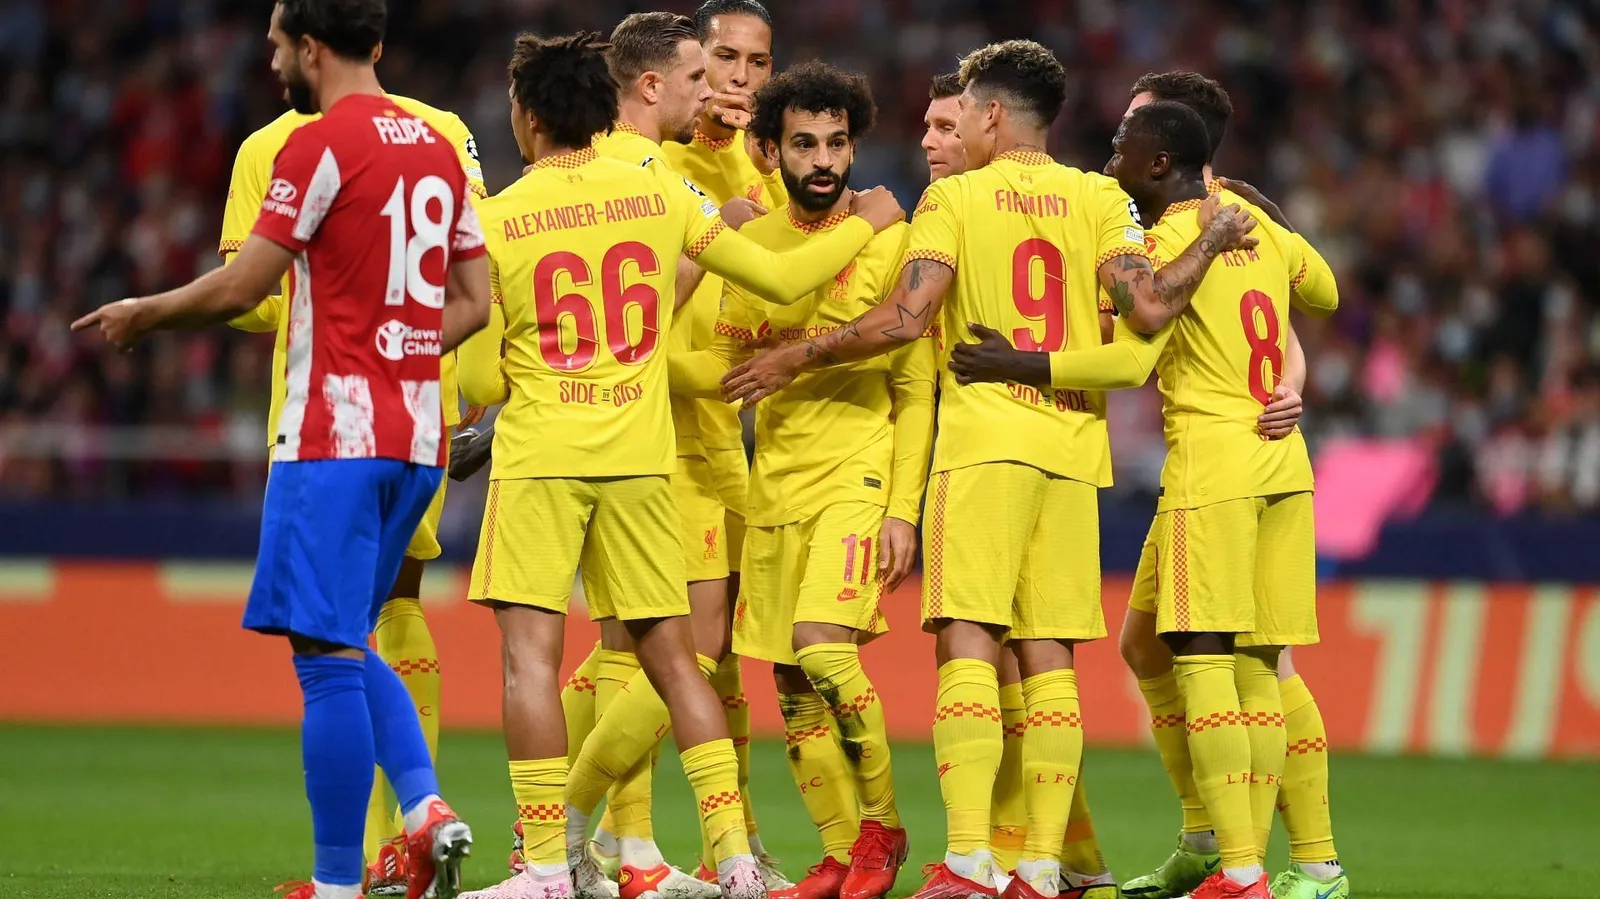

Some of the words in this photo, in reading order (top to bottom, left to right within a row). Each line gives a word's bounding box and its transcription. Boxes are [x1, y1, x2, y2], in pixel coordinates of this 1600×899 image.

[372, 116, 436, 144] FELIPE
[380, 174, 454, 309] 18
[503, 193, 666, 242] ALEXANDER-ARNOLD
[533, 241, 661, 374] 66
[1012, 238, 1068, 352] 9
[404, 341, 442, 355] Child
[780, 324, 840, 340] standar
[1240, 289, 1284, 407] 8
[559, 380, 599, 405] SIDE
[1054, 389, 1093, 412] SIDE
[842, 534, 872, 586] 11
